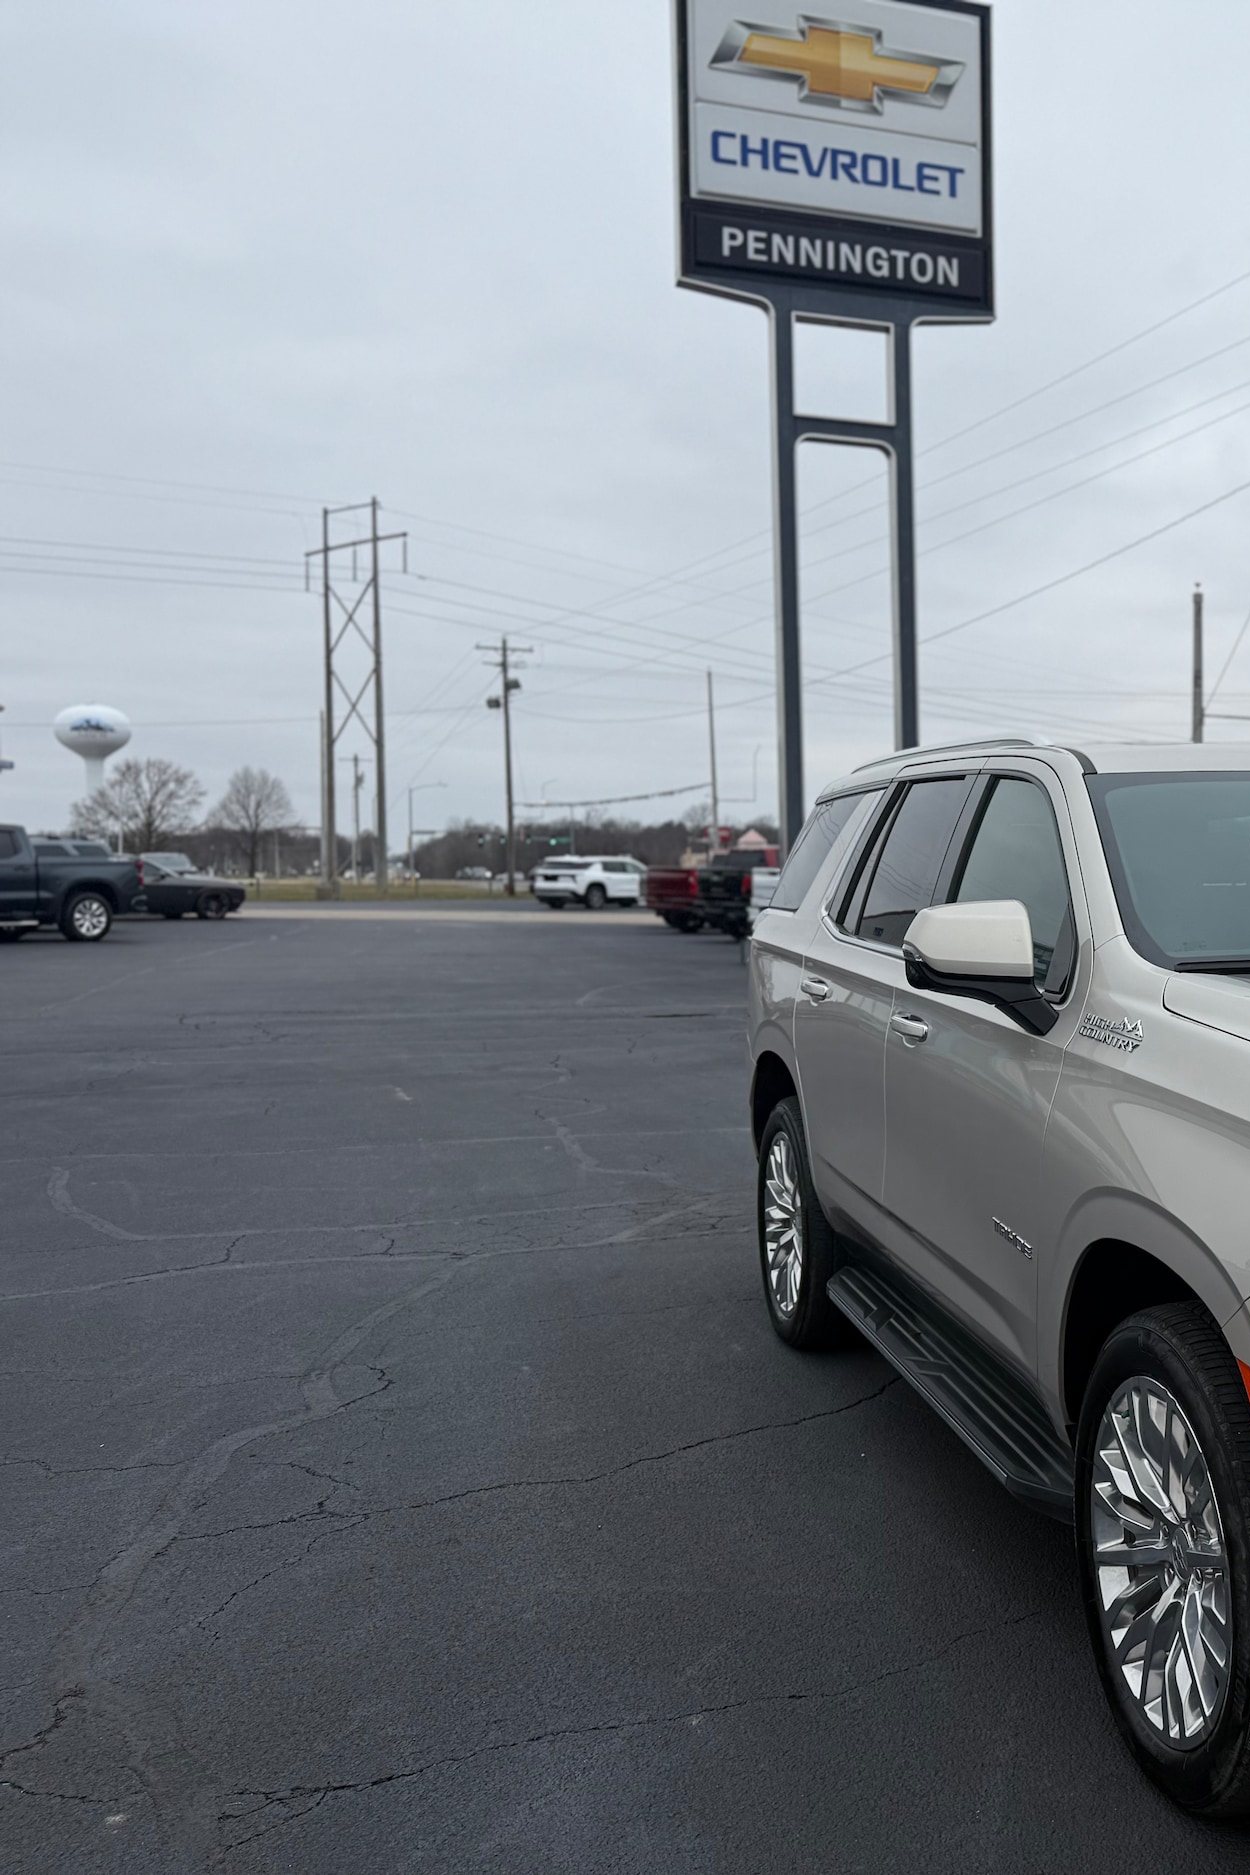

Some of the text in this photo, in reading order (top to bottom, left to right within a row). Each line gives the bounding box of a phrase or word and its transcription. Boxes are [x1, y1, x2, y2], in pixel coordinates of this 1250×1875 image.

[711, 130, 965, 198] CHEVROLET
[721, 226, 959, 287] PENNINGTON
[1079, 1025, 1140, 1053] COUNTRY
[991, 1216, 1033, 1260] TAHOE
